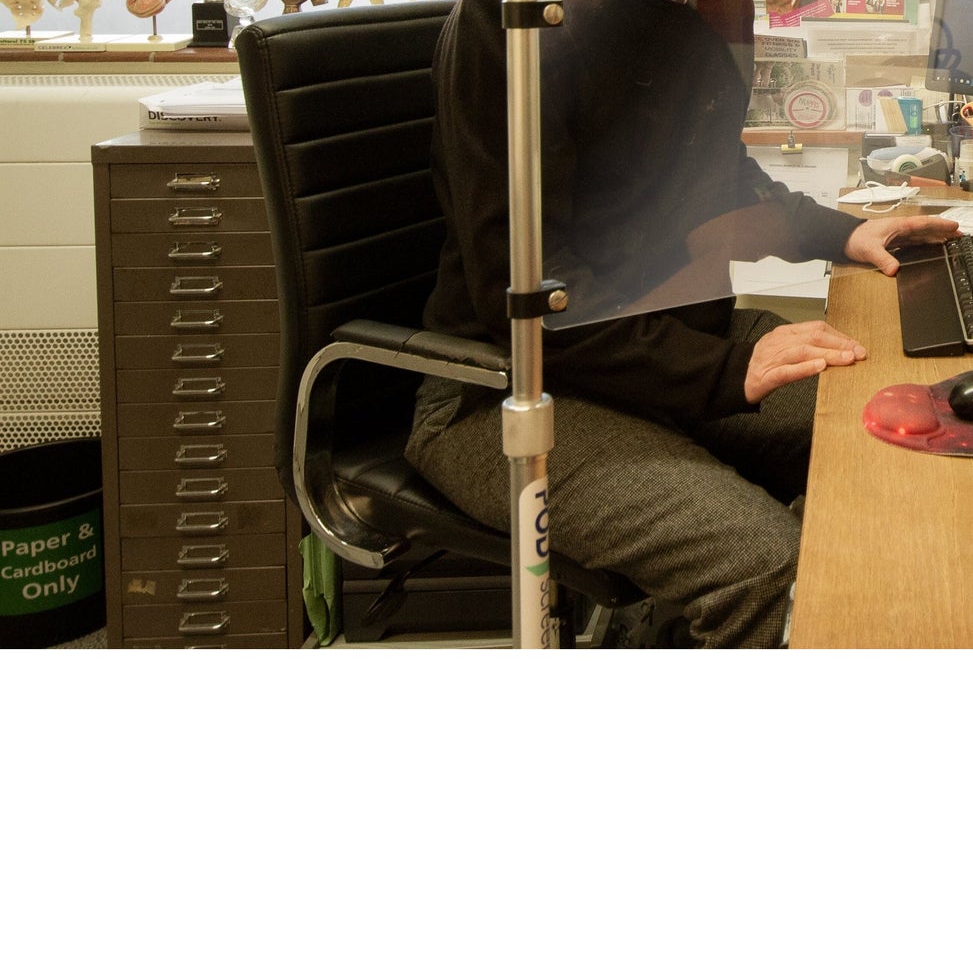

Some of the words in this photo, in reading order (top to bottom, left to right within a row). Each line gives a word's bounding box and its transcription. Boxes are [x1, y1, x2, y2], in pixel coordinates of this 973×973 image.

[1, 530, 70, 557] Paper
[78, 523, 94, 539] &
[1, 546, 97, 580] Cardboard
[22, 574, 80, 600] Only
